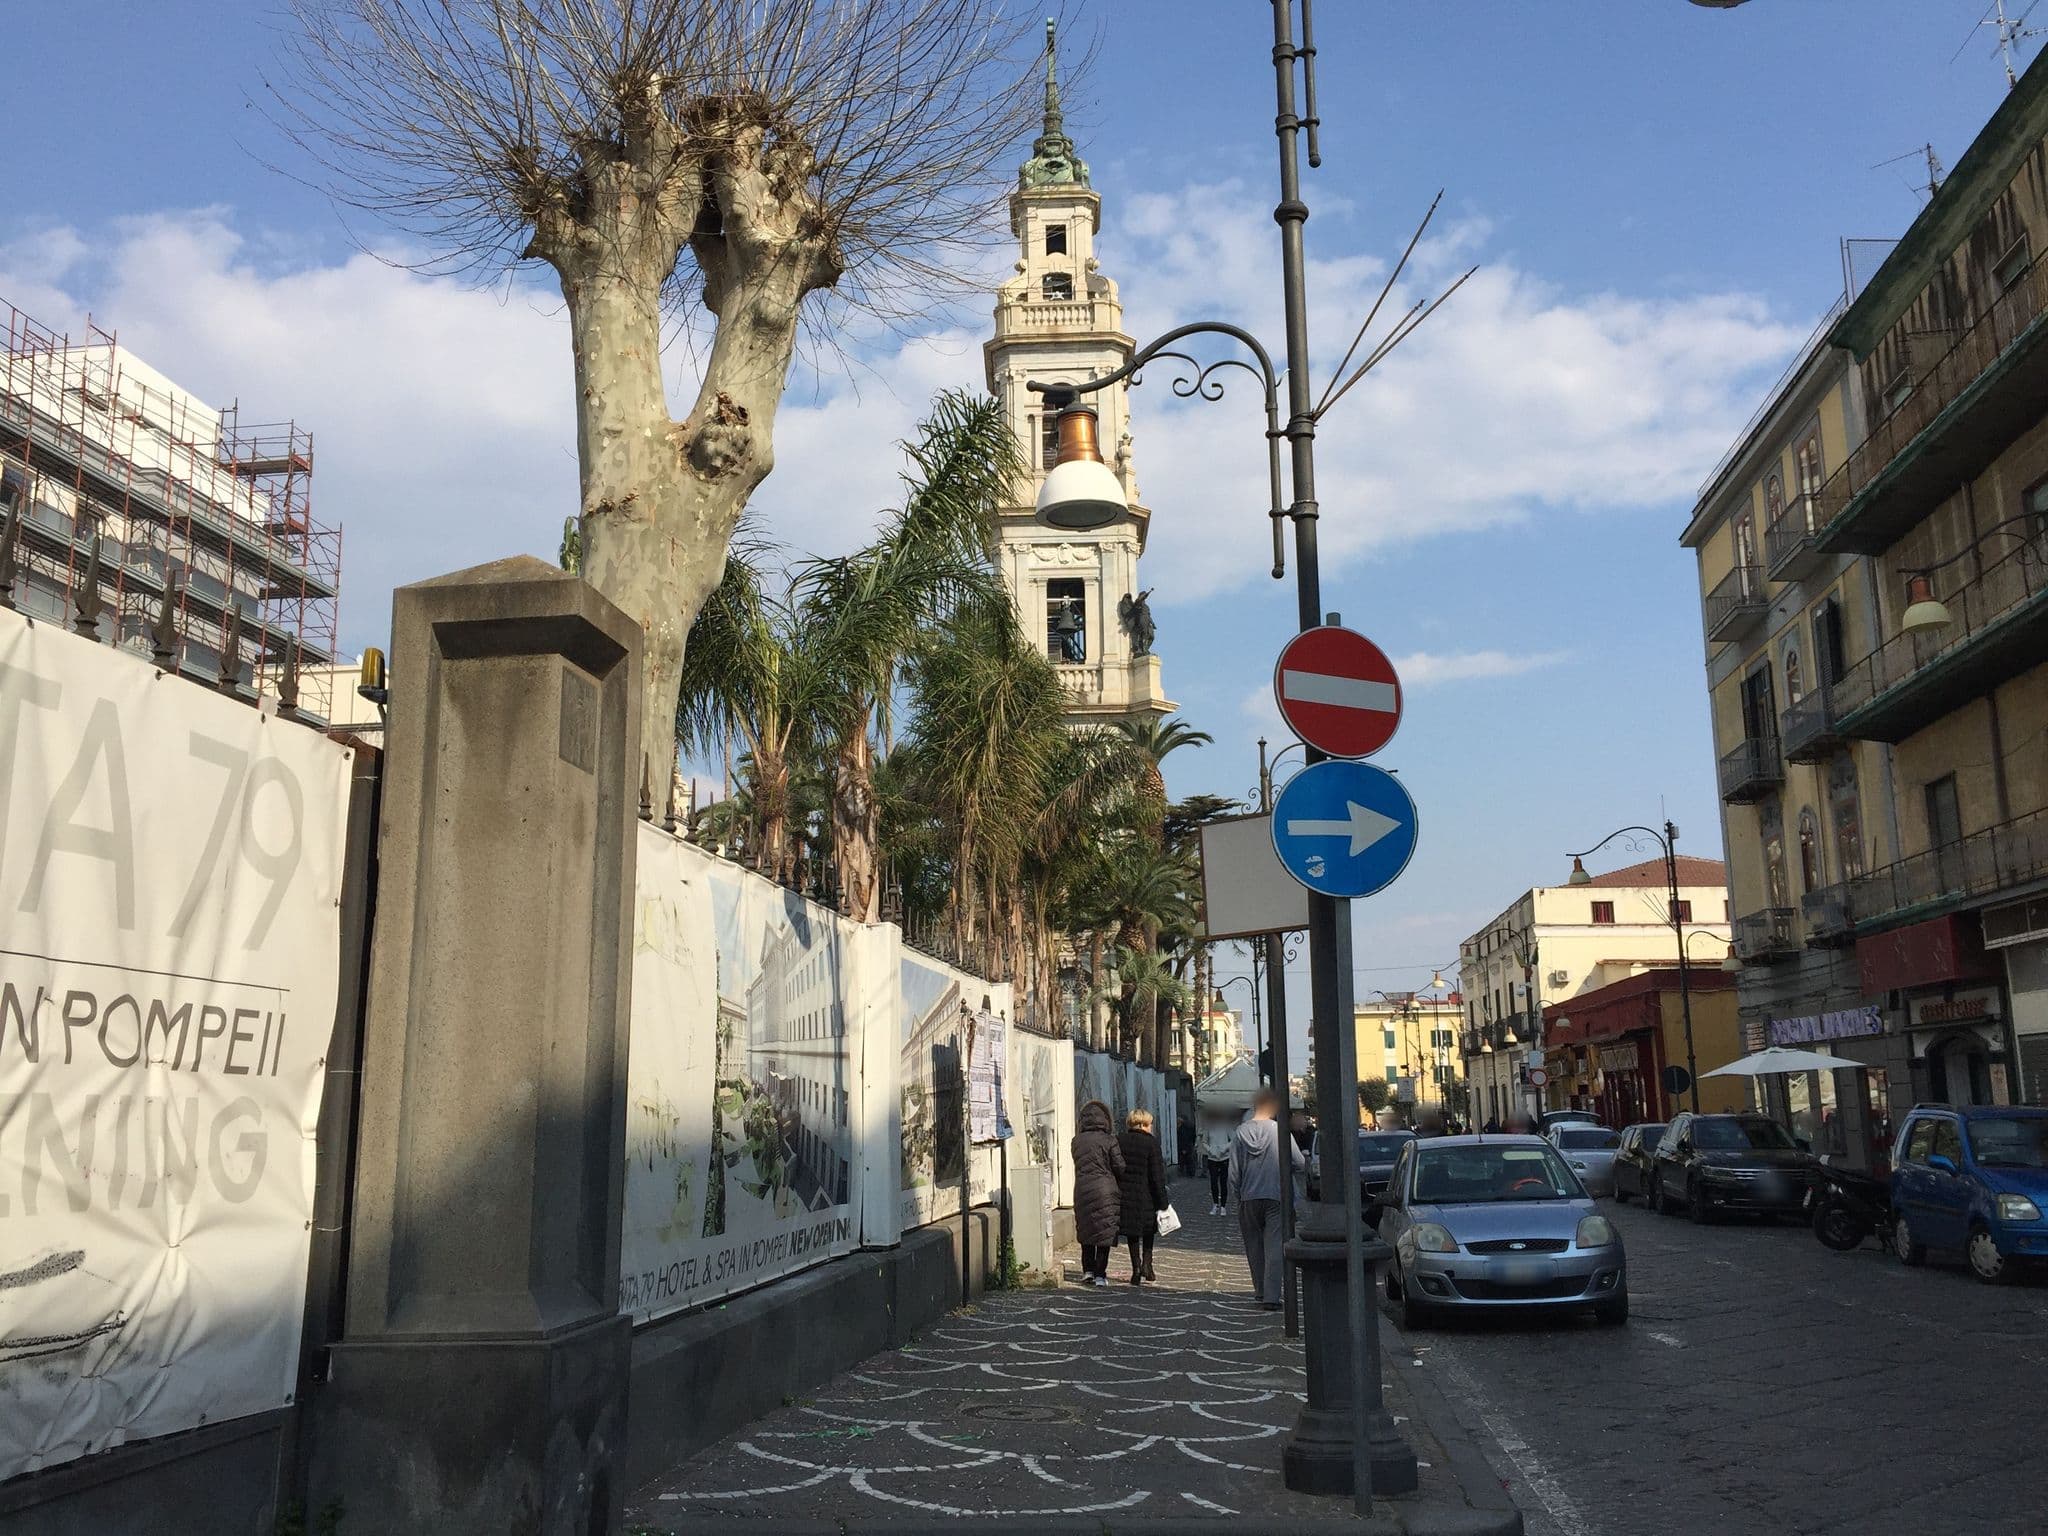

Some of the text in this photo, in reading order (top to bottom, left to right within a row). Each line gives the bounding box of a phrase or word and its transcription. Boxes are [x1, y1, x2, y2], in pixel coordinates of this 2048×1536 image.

[166, 730, 304, 951] 79
[63, 991, 286, 1077] POMPEII
[0, 1091, 268, 1216] NING
[641, 1271, 655, 1306] 79
[656, 1257, 699, 1300] HOTEL
[702, 1254, 712, 1285] &
[715, 1247, 736, 1280] SPA
[738, 1243, 752, 1274] IN
[790, 1228, 813, 1256] NEW
